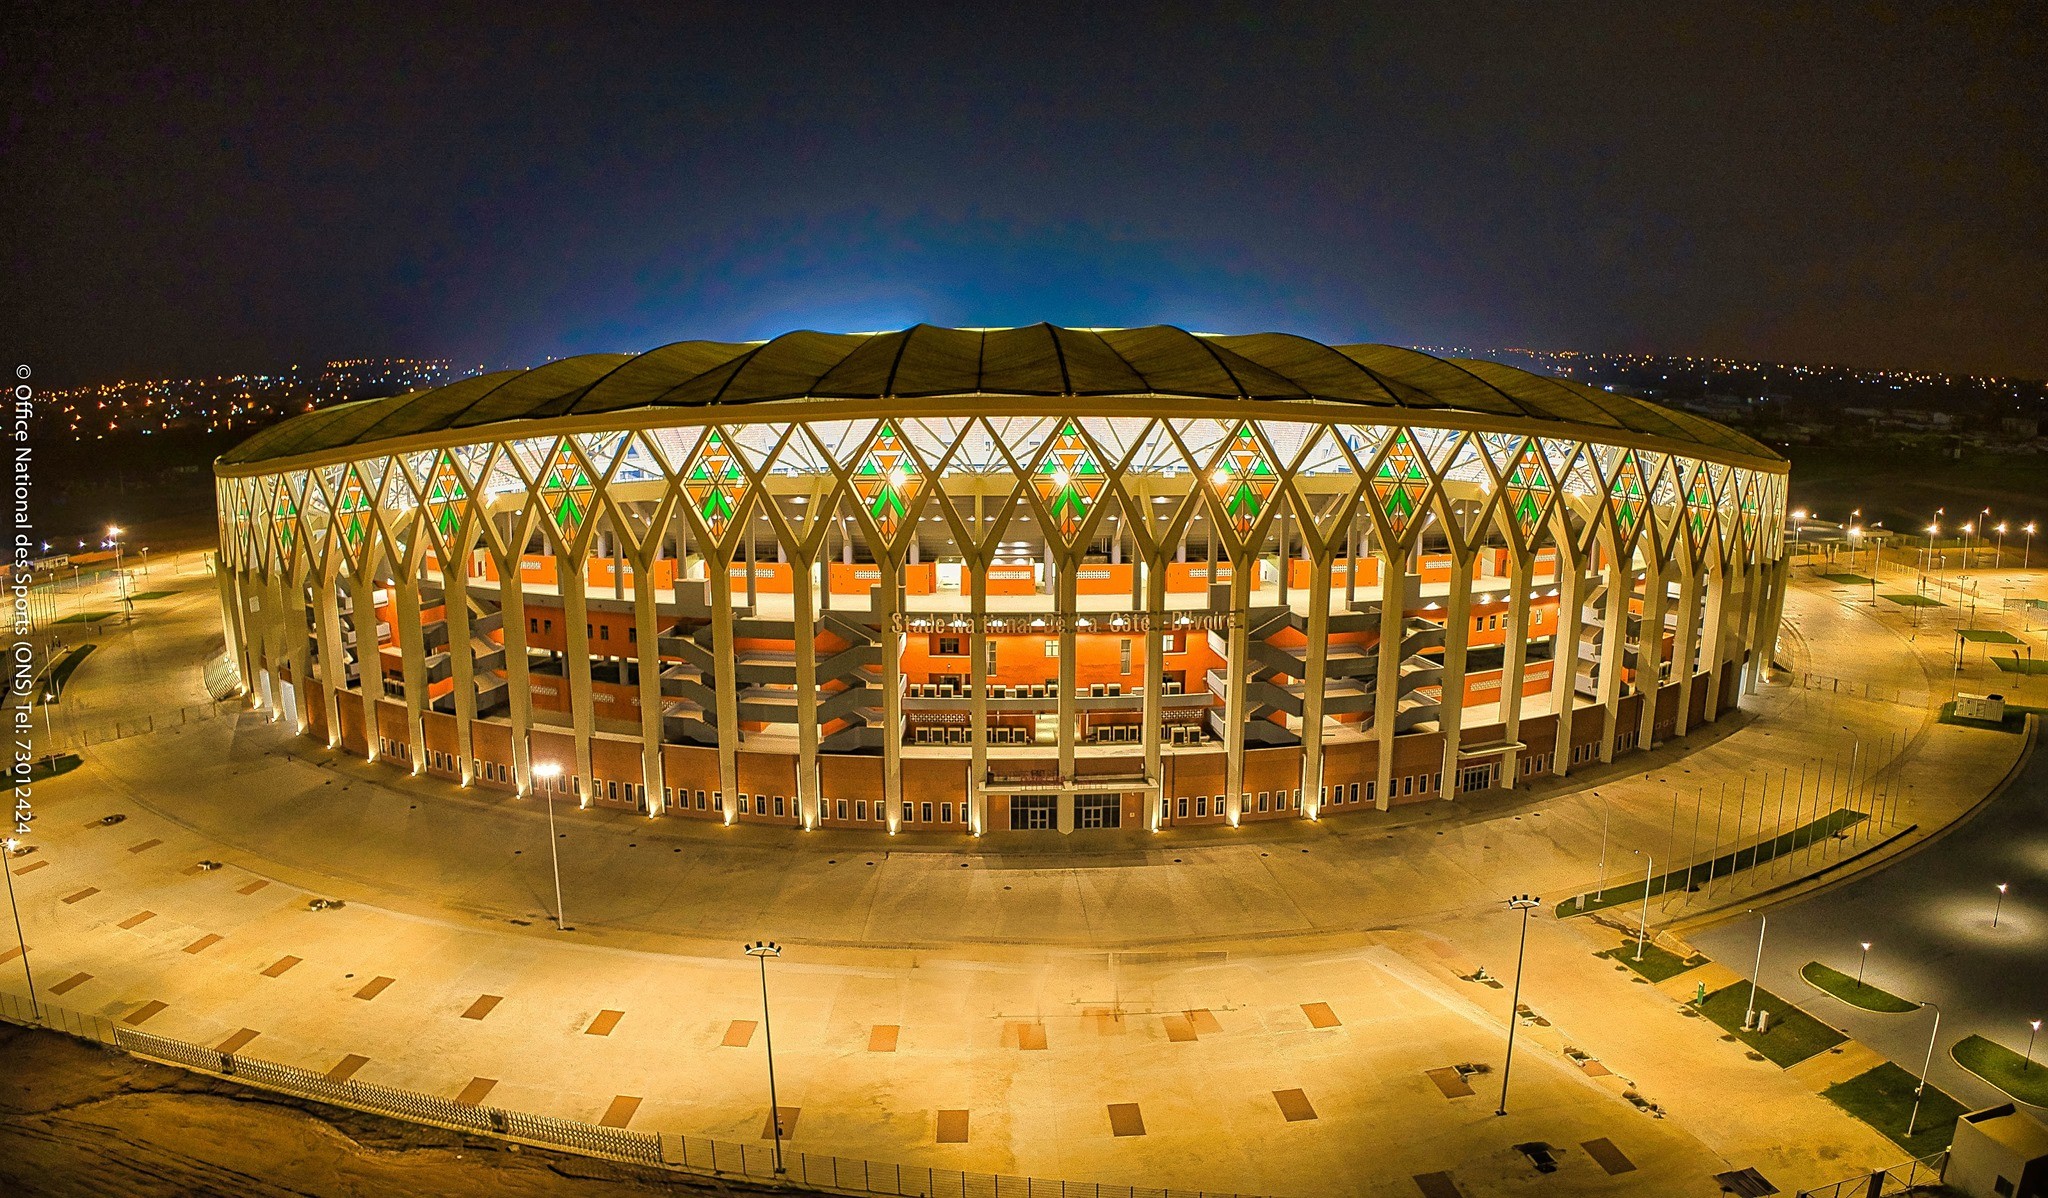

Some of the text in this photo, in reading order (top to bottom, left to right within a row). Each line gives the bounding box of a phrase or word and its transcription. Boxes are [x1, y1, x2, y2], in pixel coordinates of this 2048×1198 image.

[892, 612, 945, 634] Stade
[1043, 613, 1066, 634] De
[1076, 612, 1098, 633] La
[1109, 611, 1150, 633] Côte
